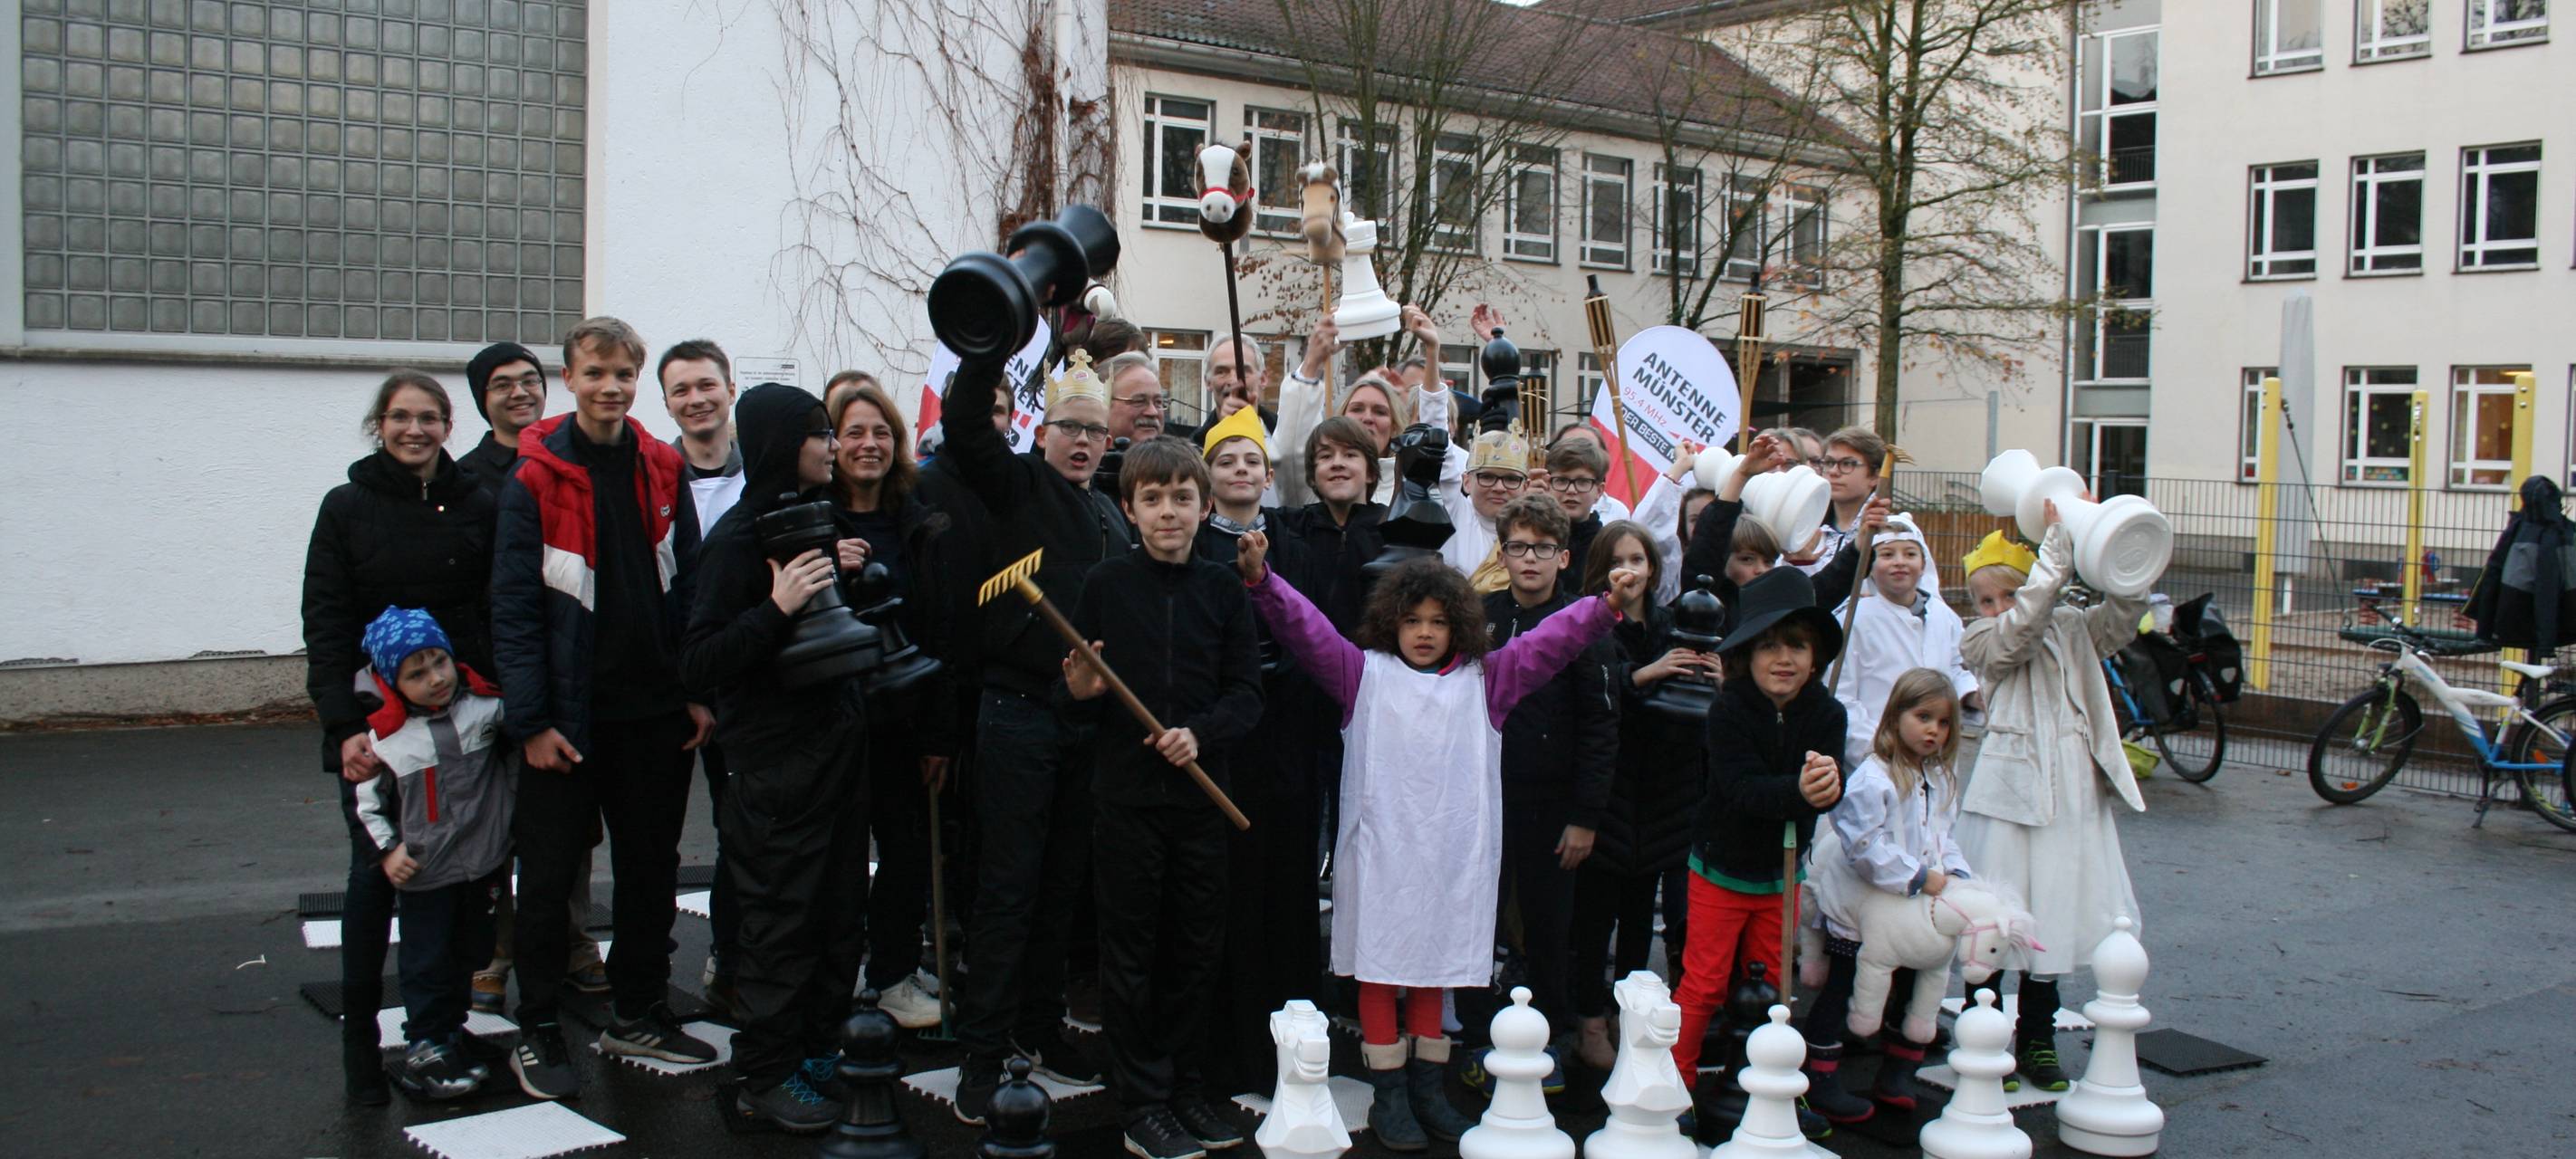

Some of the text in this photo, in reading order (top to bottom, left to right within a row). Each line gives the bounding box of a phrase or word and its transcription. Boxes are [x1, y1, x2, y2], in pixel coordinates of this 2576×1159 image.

[1624, 387, 1667, 427] 95.4 MHz
[1632, 367, 1715, 444] MÜNSTER
[1643, 352, 1726, 428] ANTENNE
[1638, 423, 1668, 453] BESTE
